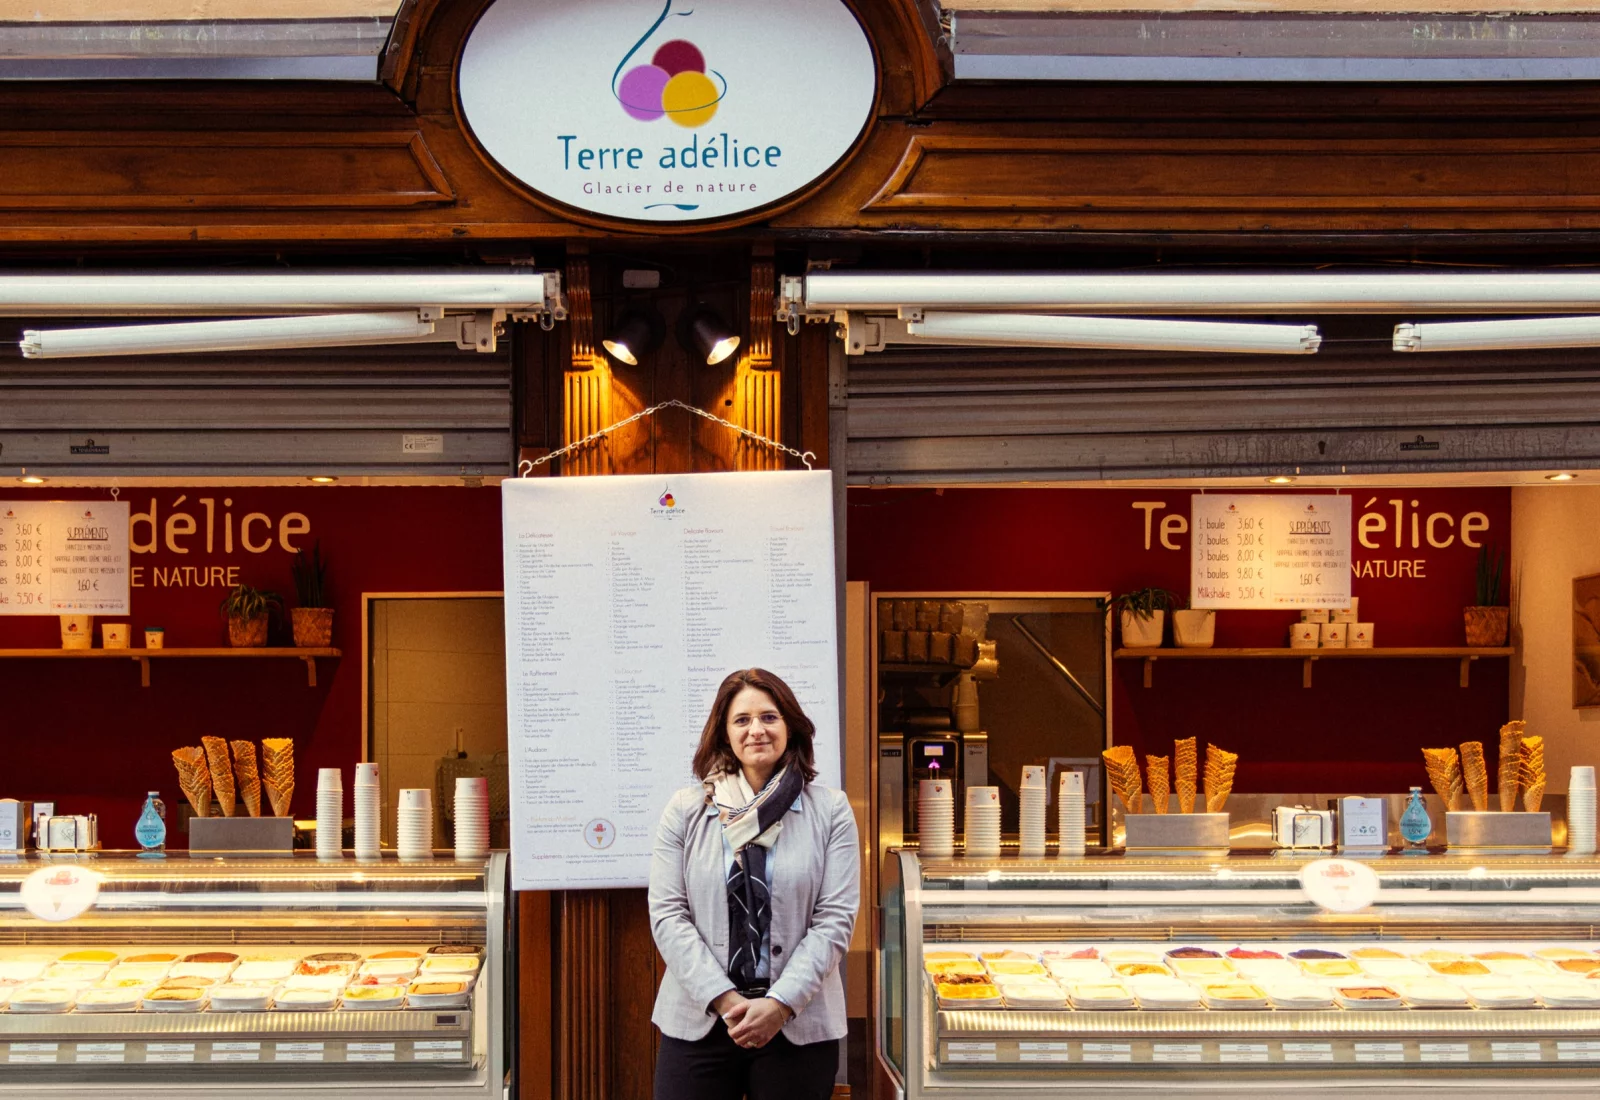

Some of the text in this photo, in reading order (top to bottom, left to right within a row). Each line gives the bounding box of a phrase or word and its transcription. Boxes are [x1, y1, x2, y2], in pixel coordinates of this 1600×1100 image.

[557, 132, 782, 171] Terre adélice
[583, 180, 758, 195] Glacier de nature
[130, 495, 311, 554] délice
[1198, 517, 1264, 530] 1 boule 3,60 €
[1289, 518, 1331, 533] SUPPLÉMENTS
[1358, 496, 1490, 549] élice
[16, 524, 42, 536] 3,60 €
[66, 524, 109, 539] SUPPLÉMENTS
[15, 540, 42, 552] 5,80 €
[1198, 534, 1264, 546] 2 boules 5,80 €
[16, 555, 42, 568] 8,00 €
[1198, 549, 1264, 562] 3 boules 8,00 €
[1197, 567, 1264, 580] 4 boules 9,80 €
[1351, 560, 1426, 578] NATURE
[16, 573, 42, 585] 9,80 €
[131, 566, 241, 587] E NATURE
[1300, 573, 1321, 586] 1,60 €
[78, 579, 99, 592] 1,60 €
[16, 592, 43, 605] 5,50 €
[1197, 587, 1265, 599] Milkshake 5,50 €
